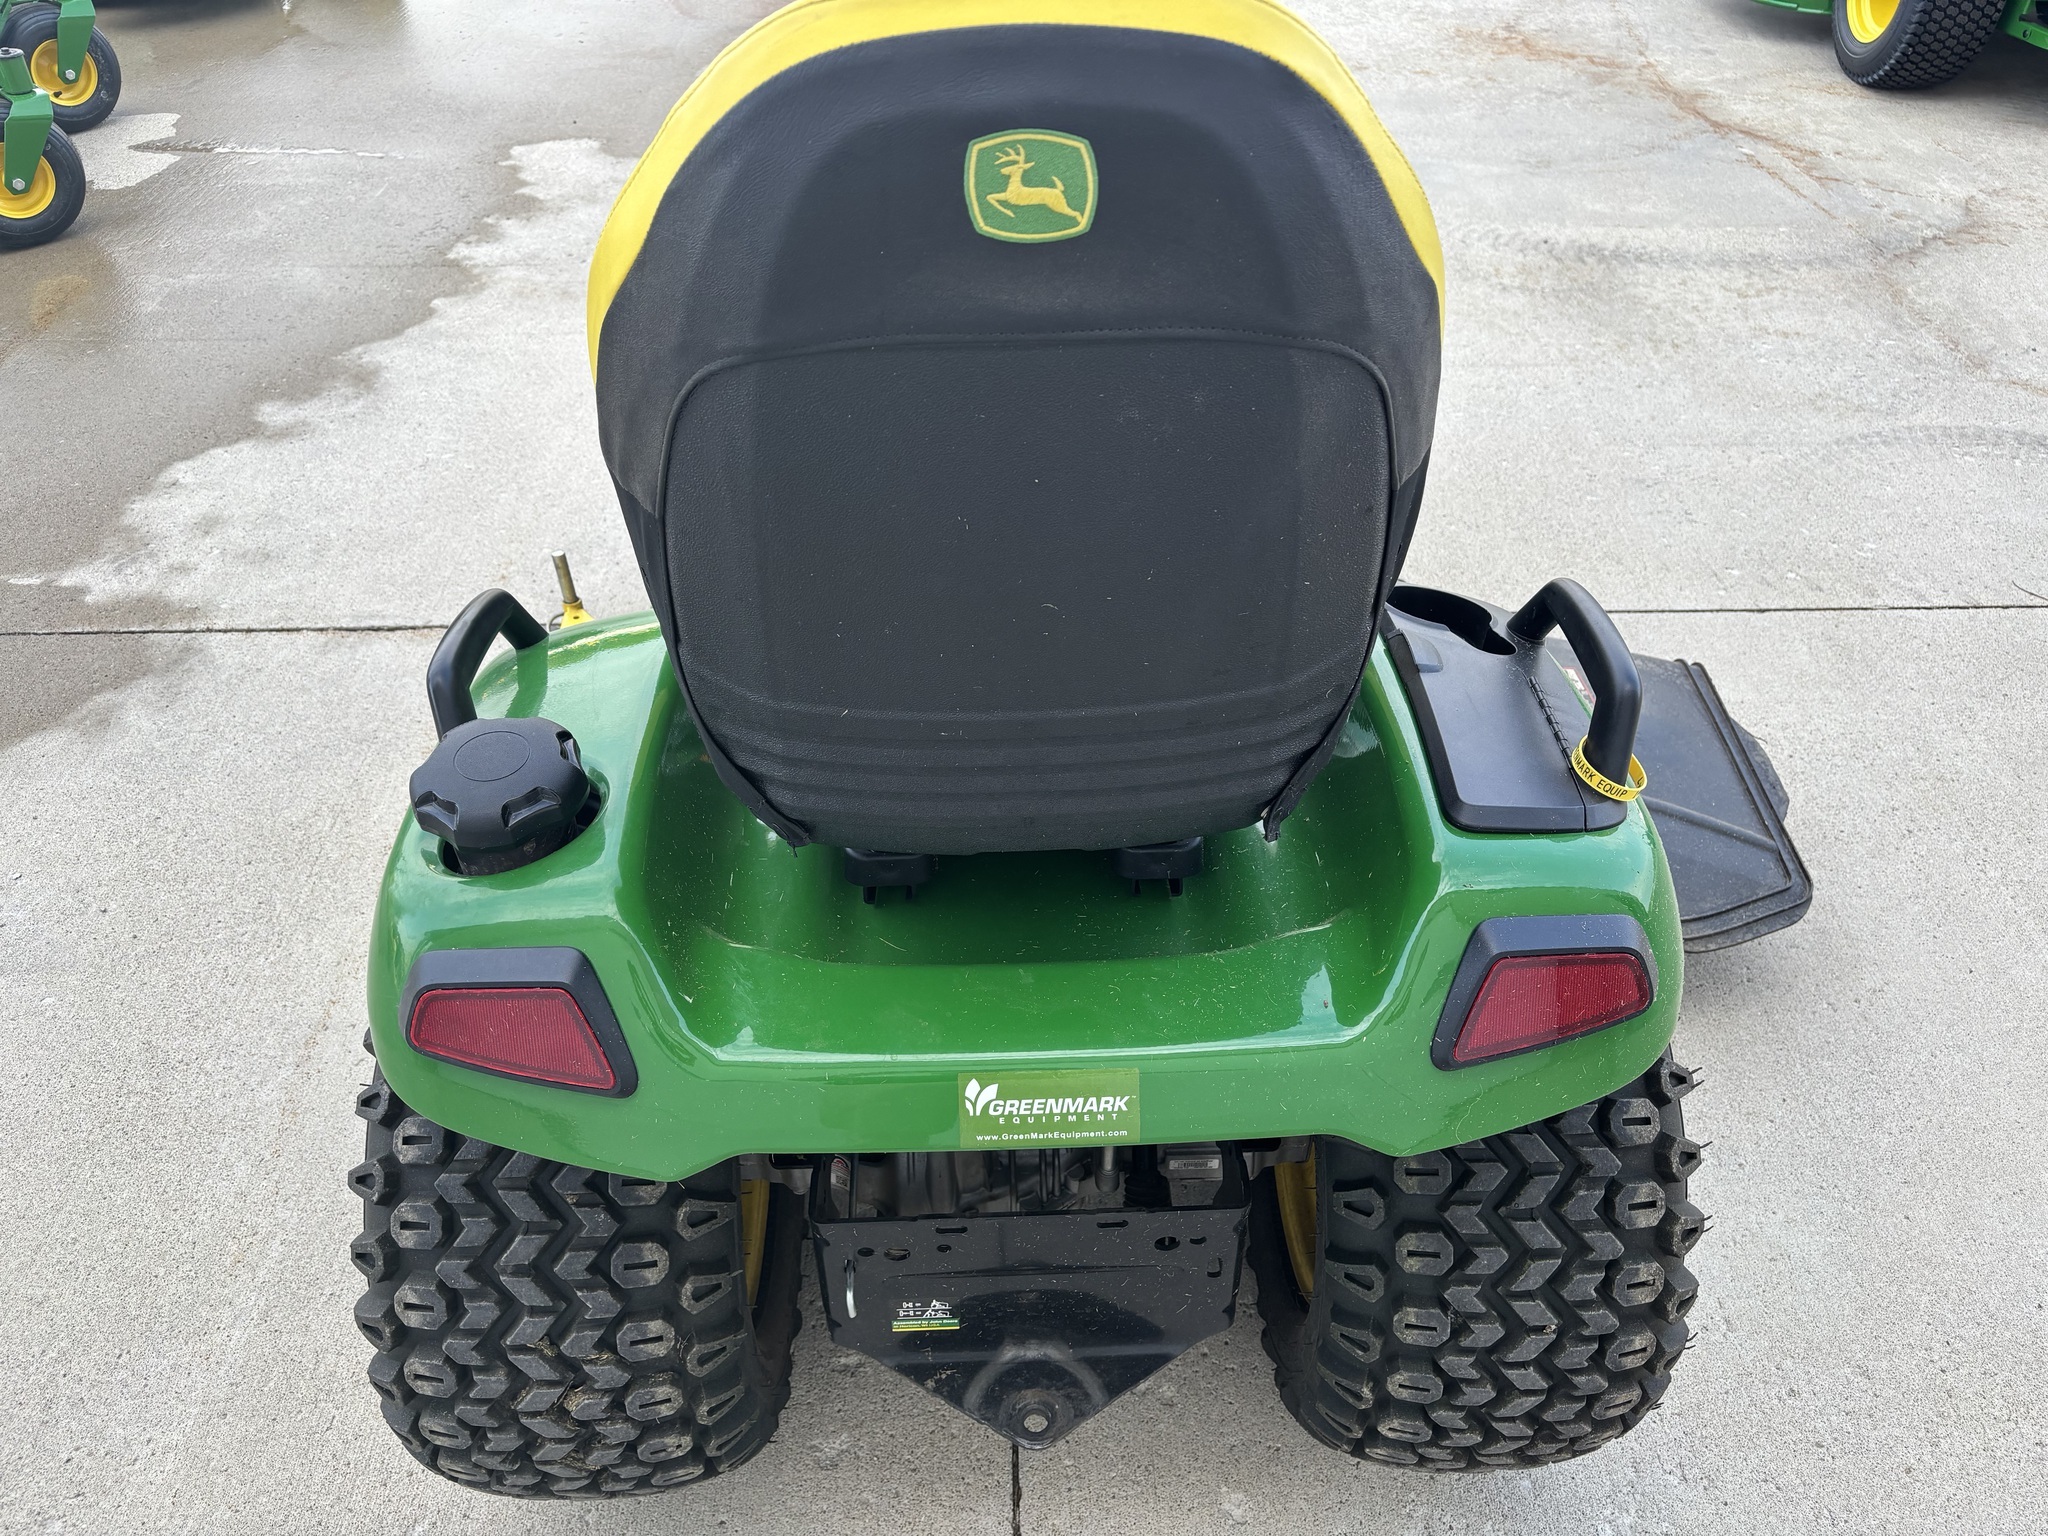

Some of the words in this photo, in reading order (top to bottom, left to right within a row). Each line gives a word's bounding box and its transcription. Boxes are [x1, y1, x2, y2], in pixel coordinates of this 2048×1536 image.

[1596, 779, 1628, 798] EQUIP
[988, 1095, 1130, 1116] GREENMARK
[999, 1113, 1118, 1124] EQUIPMENT
[976, 1130, 1128, 1141] www.GreenMarkEquipment.com
